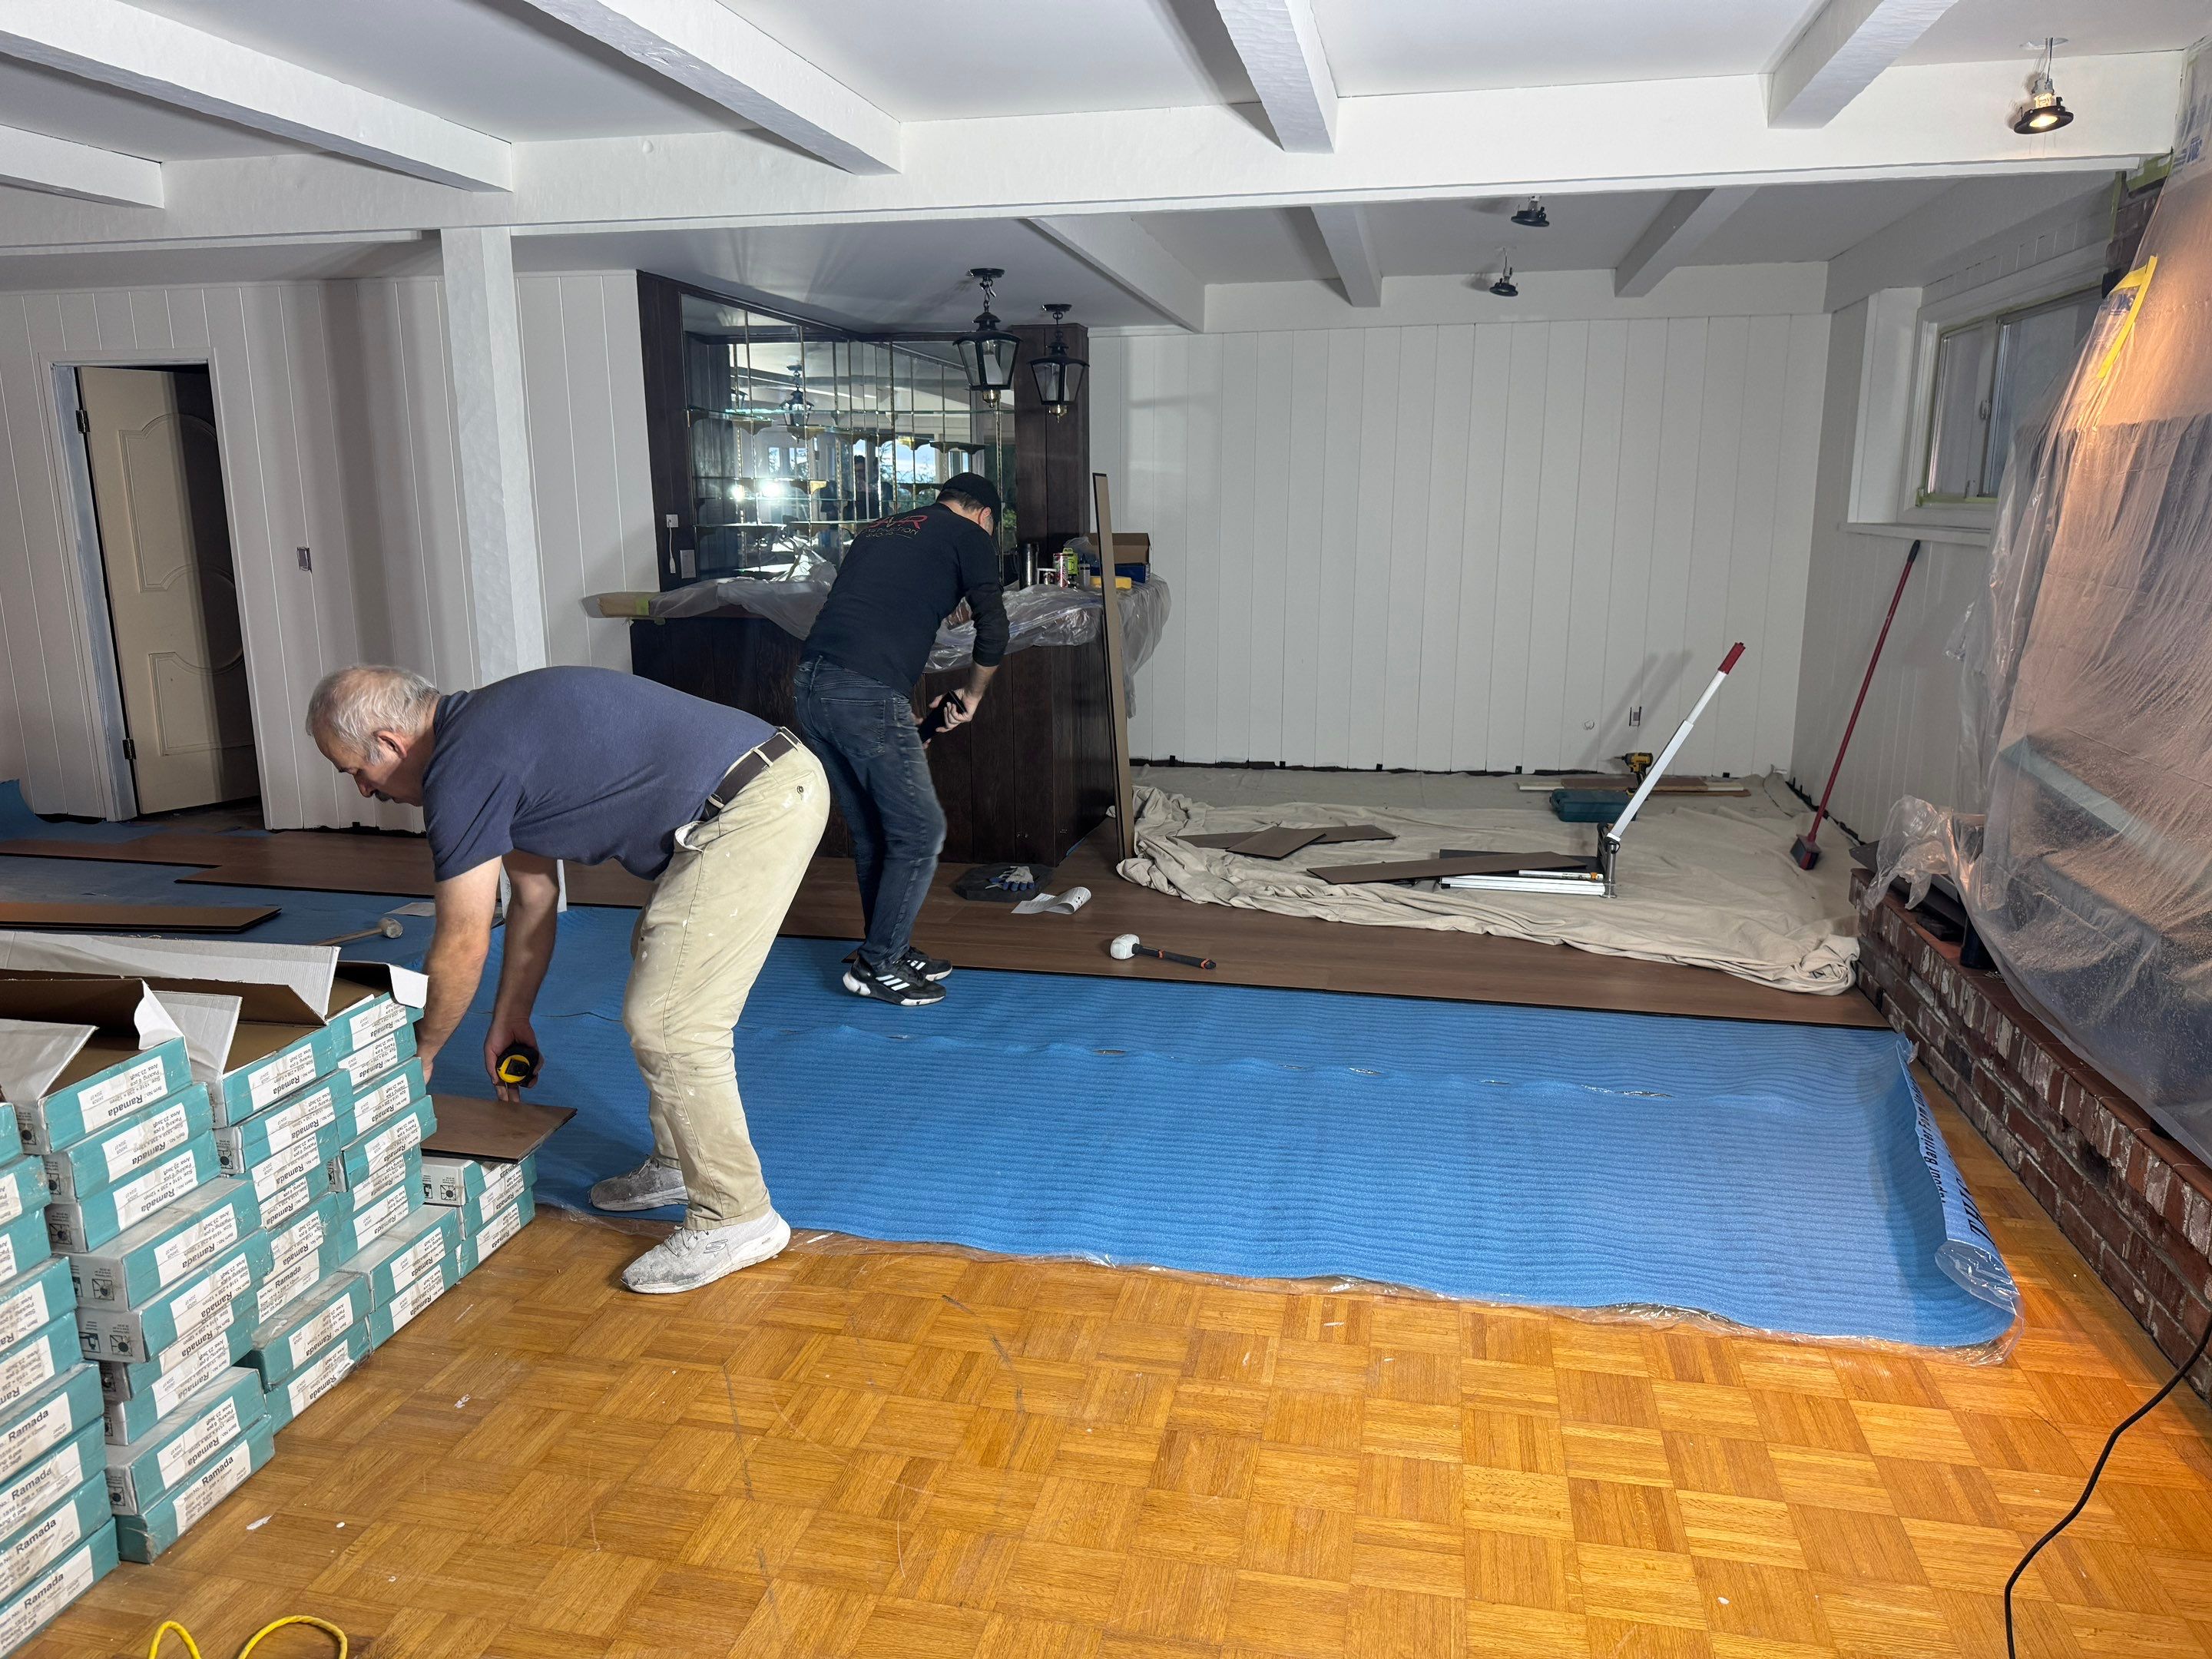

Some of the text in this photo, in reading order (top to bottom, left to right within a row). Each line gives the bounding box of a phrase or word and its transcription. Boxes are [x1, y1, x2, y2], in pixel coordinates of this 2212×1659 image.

[369, 1020, 393, 1037] Ramada
[139, 1081, 149, 1090] 1516
[273, 1075, 300, 1094] Ramada
[107, 1094, 143, 1116] Ramada
[371, 1104, 394, 1121] Ramada
[291, 1118, 319, 1138] Ramada
[131, 1141, 166, 1164] Ramada
[382, 1143, 406, 1161] Ramada
[1921, 1128, 1938, 1165] Barrier
[276, 1163, 303, 1184] Ramada
[141, 1187, 174, 1212] Ramada
[266, 1202, 293, 1224] Ramada
[181, 1243, 215, 1268] Ramada
[282, 1243, 308, 1264] Ramada
[275, 1266, 301, 1289] Ramada
[411, 1256, 432, 1276] Ramada
[200, 1290, 232, 1318] Ramada
[409, 1293, 431, 1316] Ramada
[181, 1329, 212, 1356] Ramada
[306, 1331, 332, 1356] Ramada
[177, 1371, 209, 1398] Ramada
[309, 1373, 336, 1401] Ramada
[8, 1409, 49, 1442] Ramada
[187, 1435, 219, 1465] Ramada
[202, 1455, 233, 1487] Ramada
[12, 1468, 52, 1500] Ramada
[15, 1518, 57, 1555] Ramada
[24, 1573, 65, 1609] Ramada
